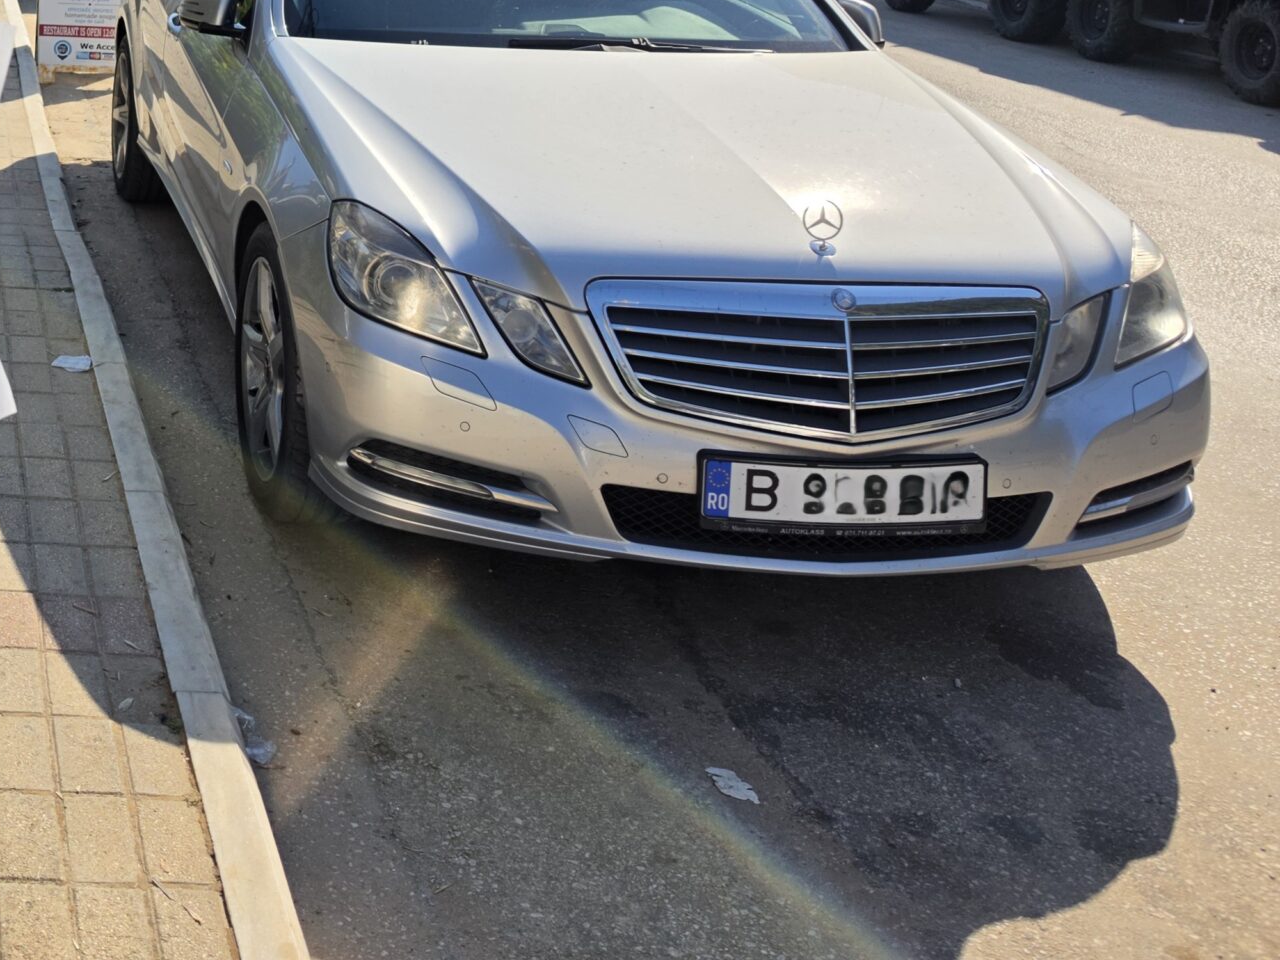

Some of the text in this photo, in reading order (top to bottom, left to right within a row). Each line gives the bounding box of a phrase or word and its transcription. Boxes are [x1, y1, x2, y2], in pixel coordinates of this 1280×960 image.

[43, 25, 79, 36] RESTAURANT
[80, 27, 86, 36] IS
[86, 27, 102, 37] OPEN
[80, 42, 116, 51] We Acce
[707, 492, 728, 510] RO
[745, 469, 779, 512] B
[780, 527, 825, 535] AUTOKLASS
